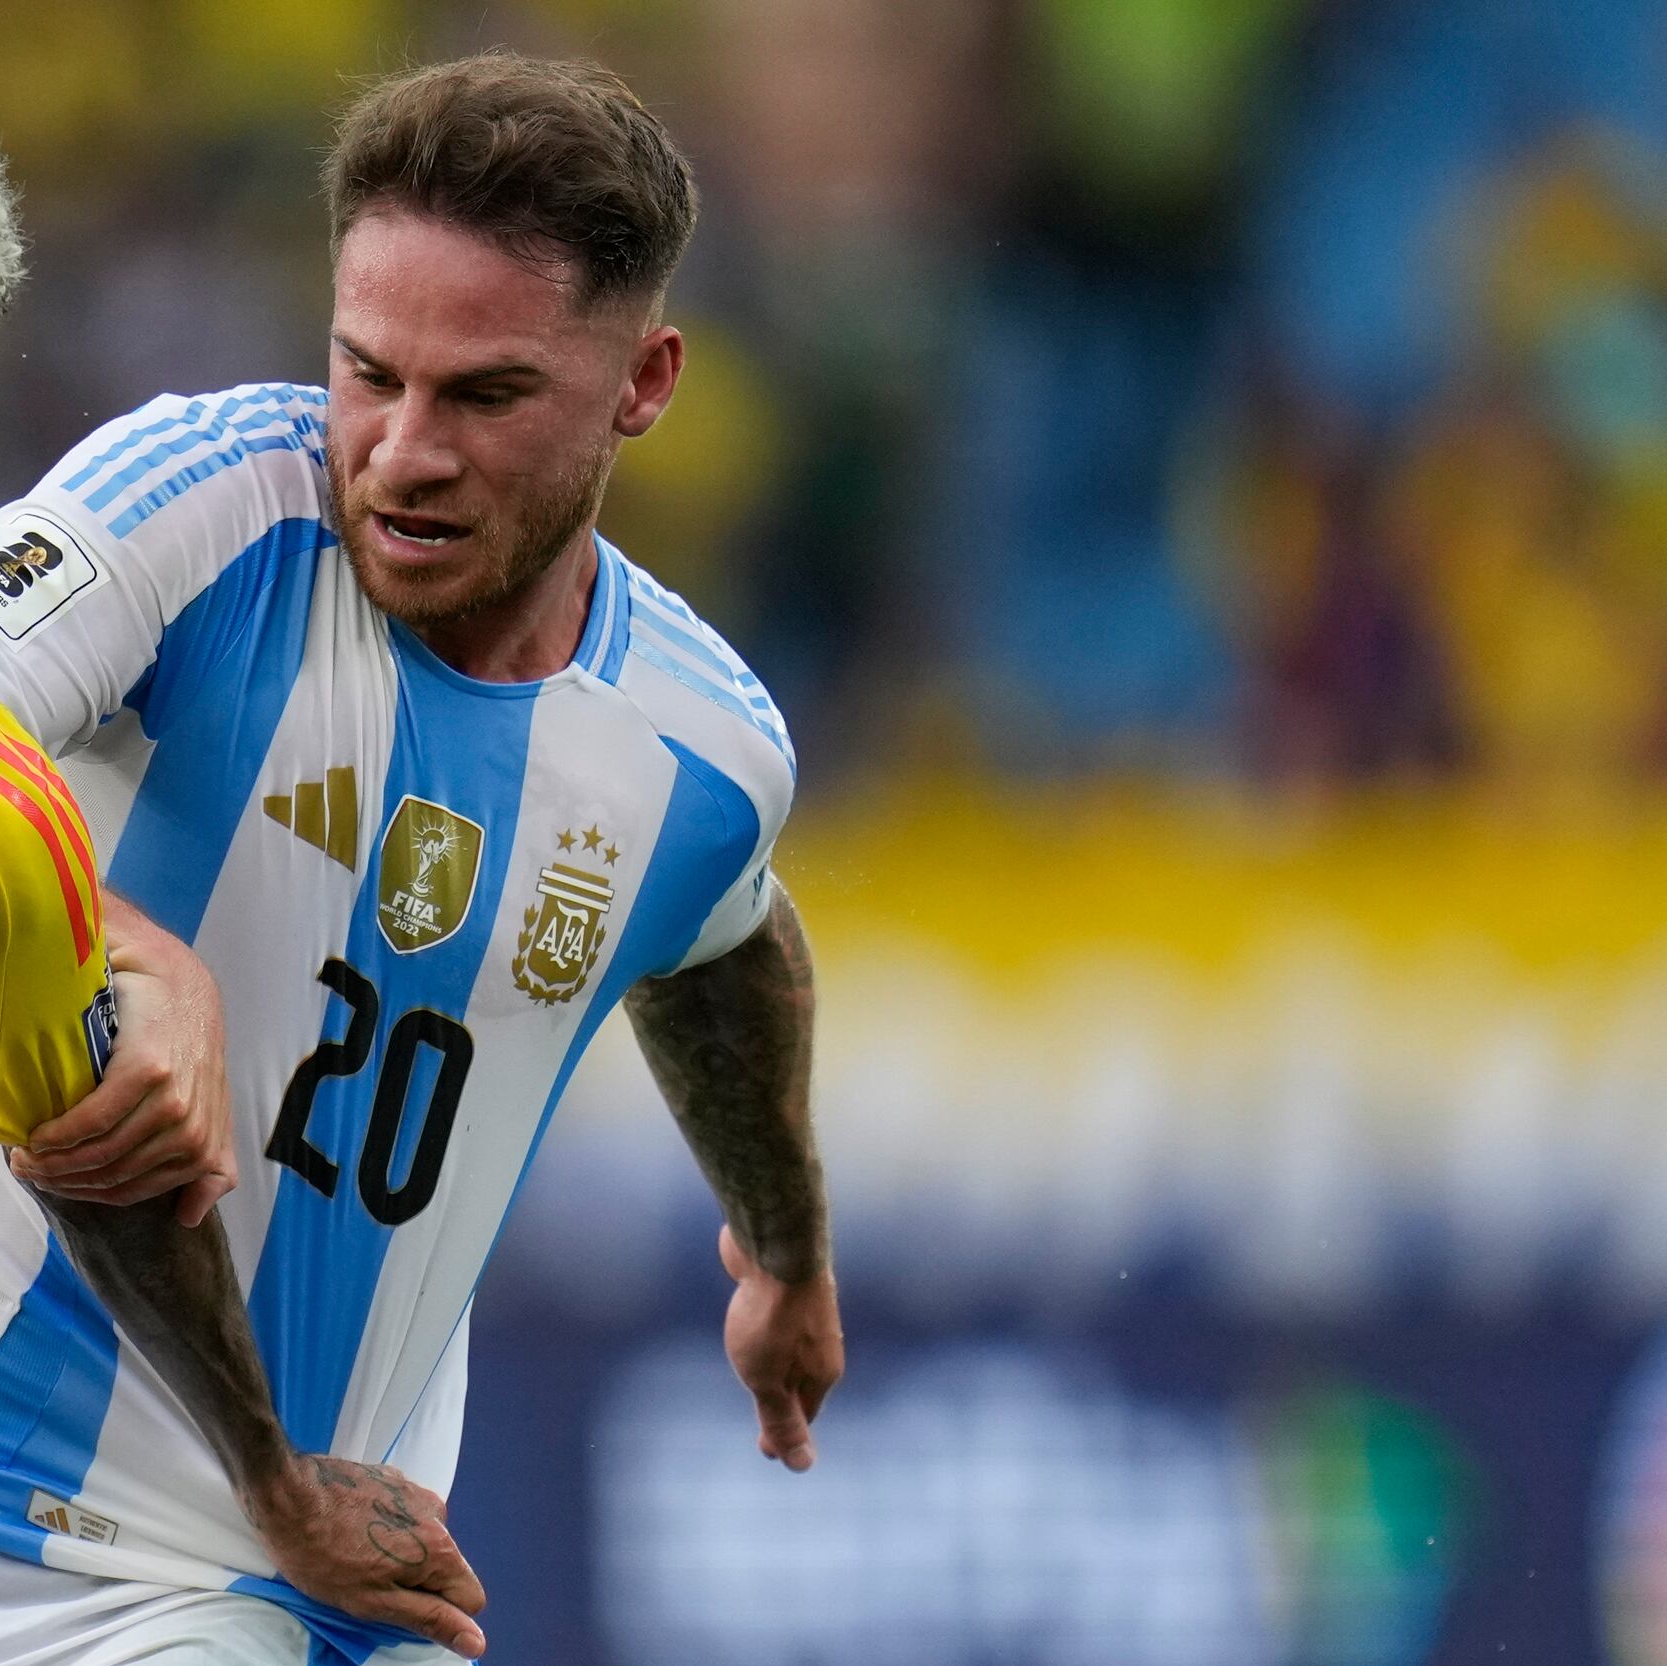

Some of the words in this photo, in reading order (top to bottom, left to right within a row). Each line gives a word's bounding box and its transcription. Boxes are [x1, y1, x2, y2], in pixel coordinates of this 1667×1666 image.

[379, 903, 403, 917] WORLD
[403, 914, 442, 935] CHAMPIONS
[392, 890, 434, 923] FIFA
[393, 918, 419, 937] 2022
[536, 900, 589, 969] AFA
[264, 957, 475, 1227] 20
